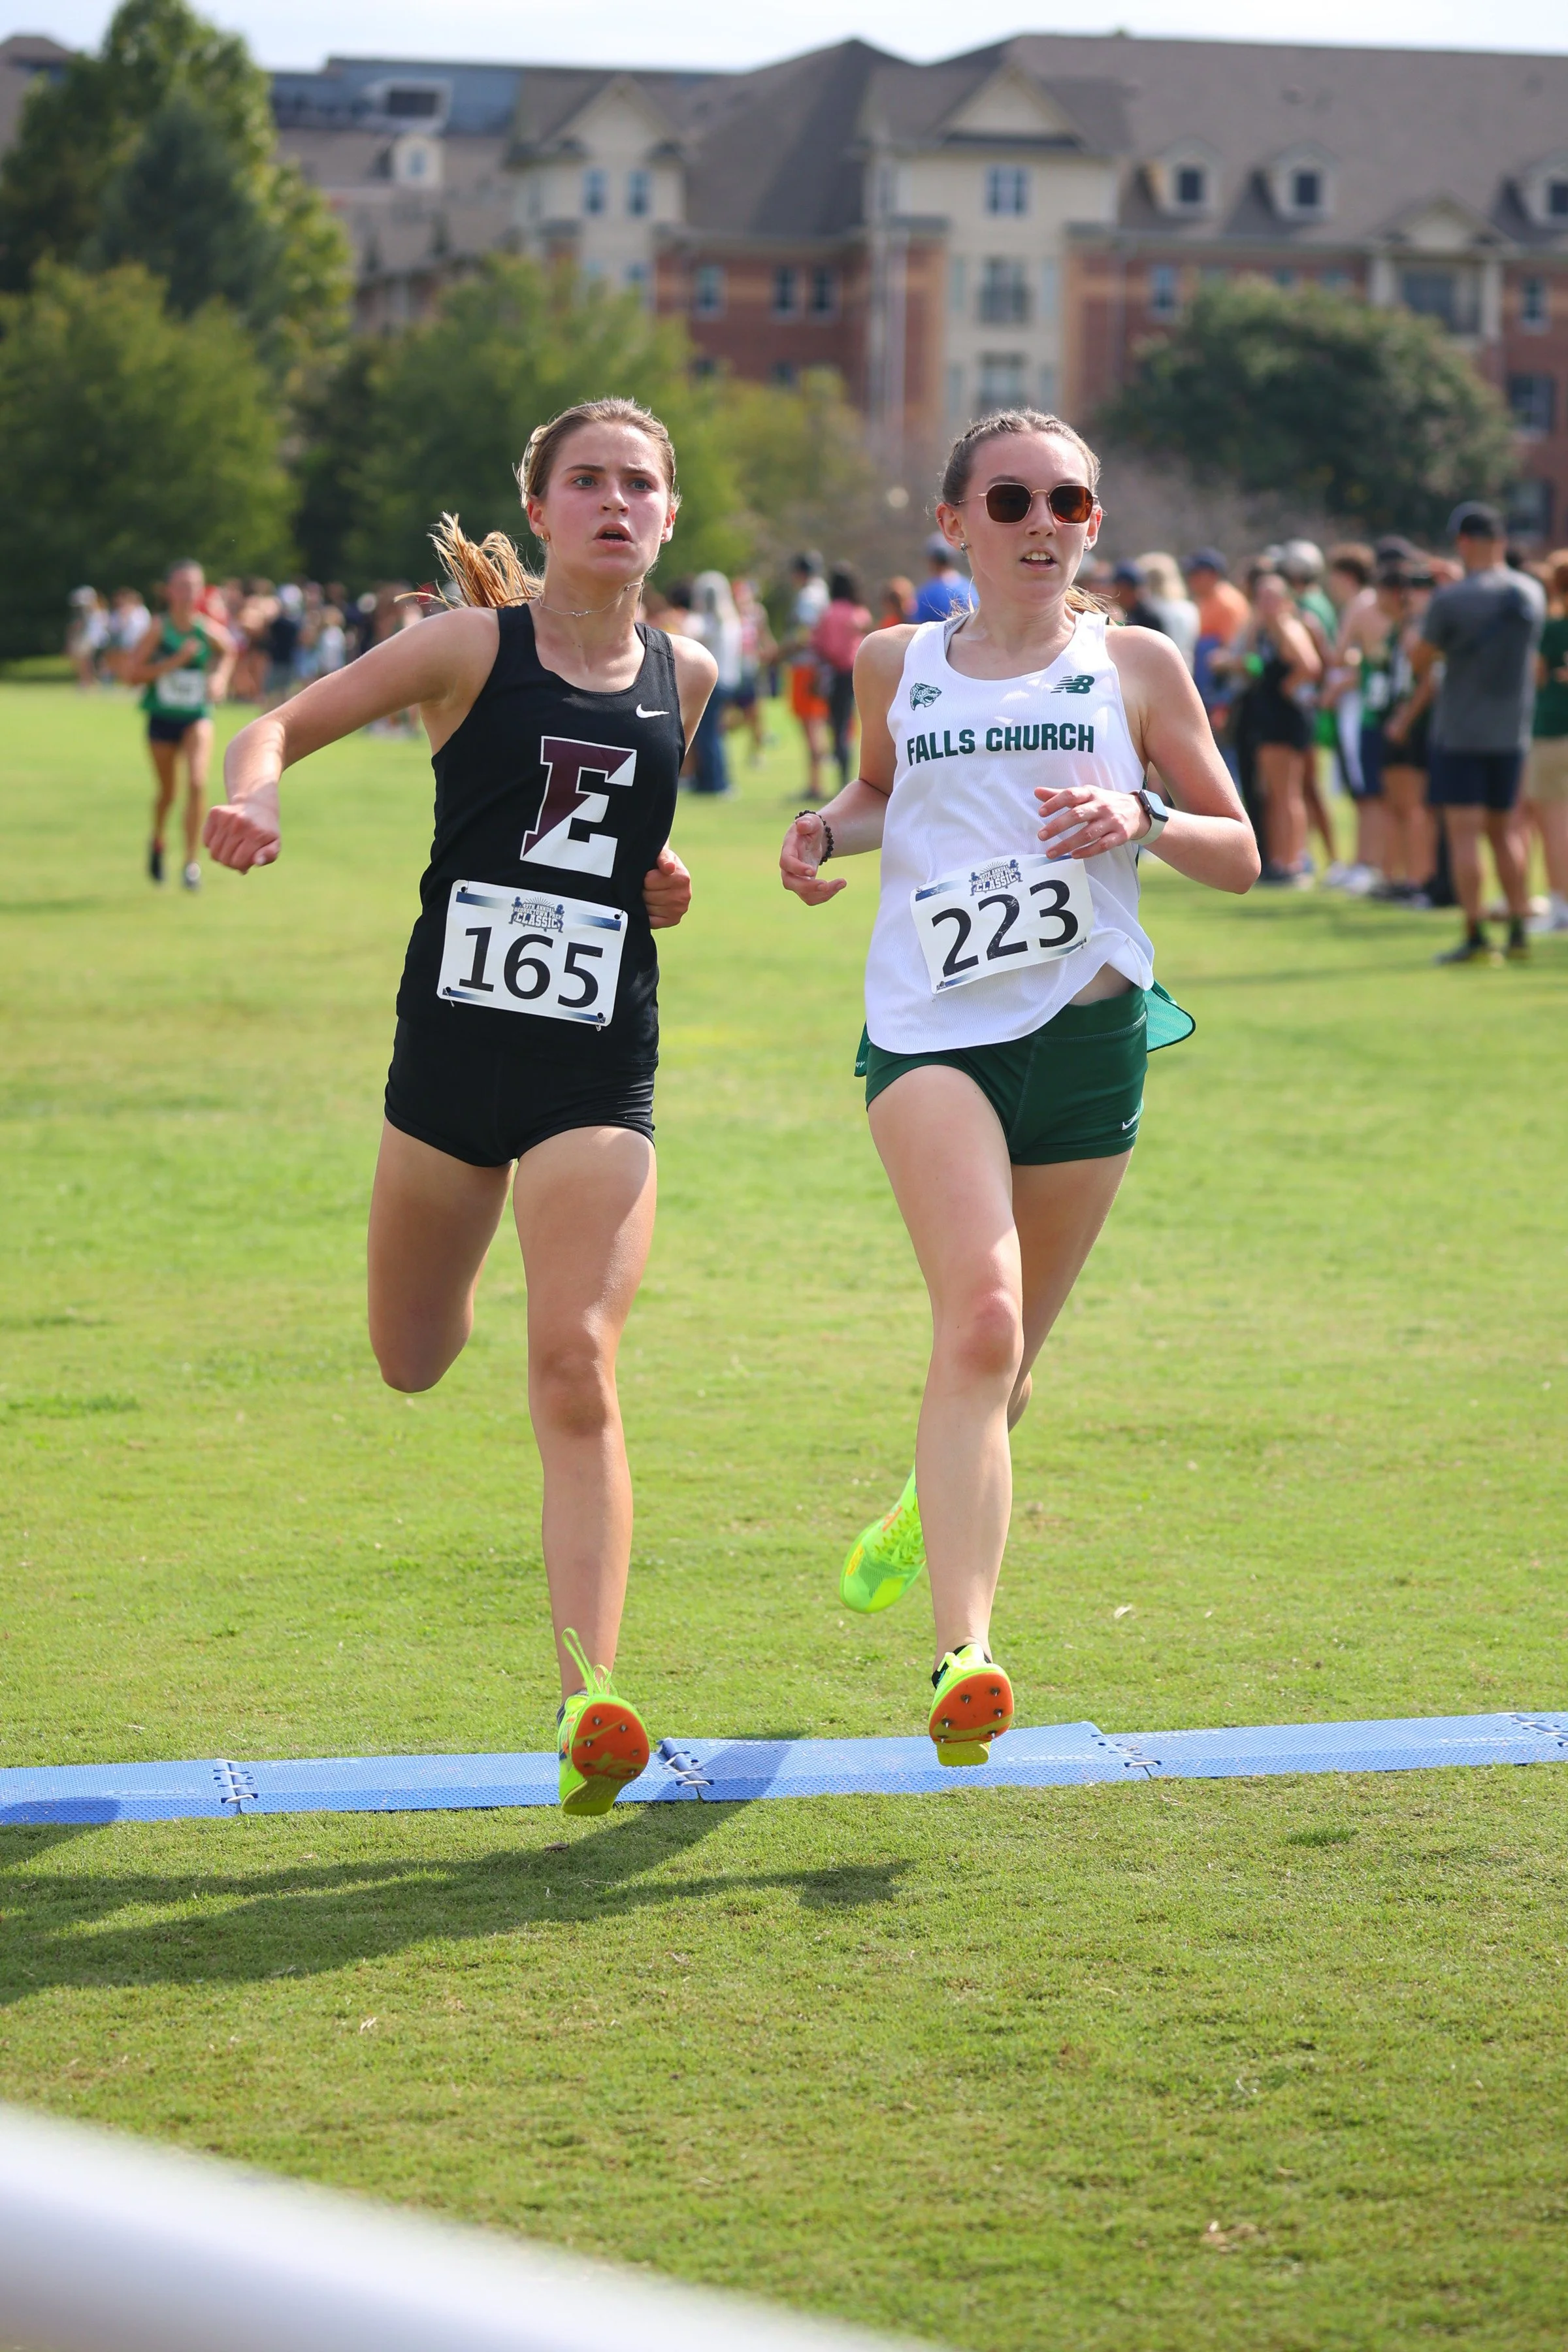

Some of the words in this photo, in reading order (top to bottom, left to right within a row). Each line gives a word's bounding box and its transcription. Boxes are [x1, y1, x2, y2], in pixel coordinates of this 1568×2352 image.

[907, 729, 975, 766] FALLS
[986, 723, 1094, 753] CHURCH
[520, 736, 637, 878] E
[972, 872, 1004, 885] GEORGETOWN
[975, 873, 1017, 892] CLASSIC
[514, 907, 548, 917] GEORGETOWN
[536, 905, 555, 913] ANNUAL
[515, 912, 558, 928] CLASSIC
[931, 879, 1078, 977] 223
[459, 926, 603, 1008] 165
